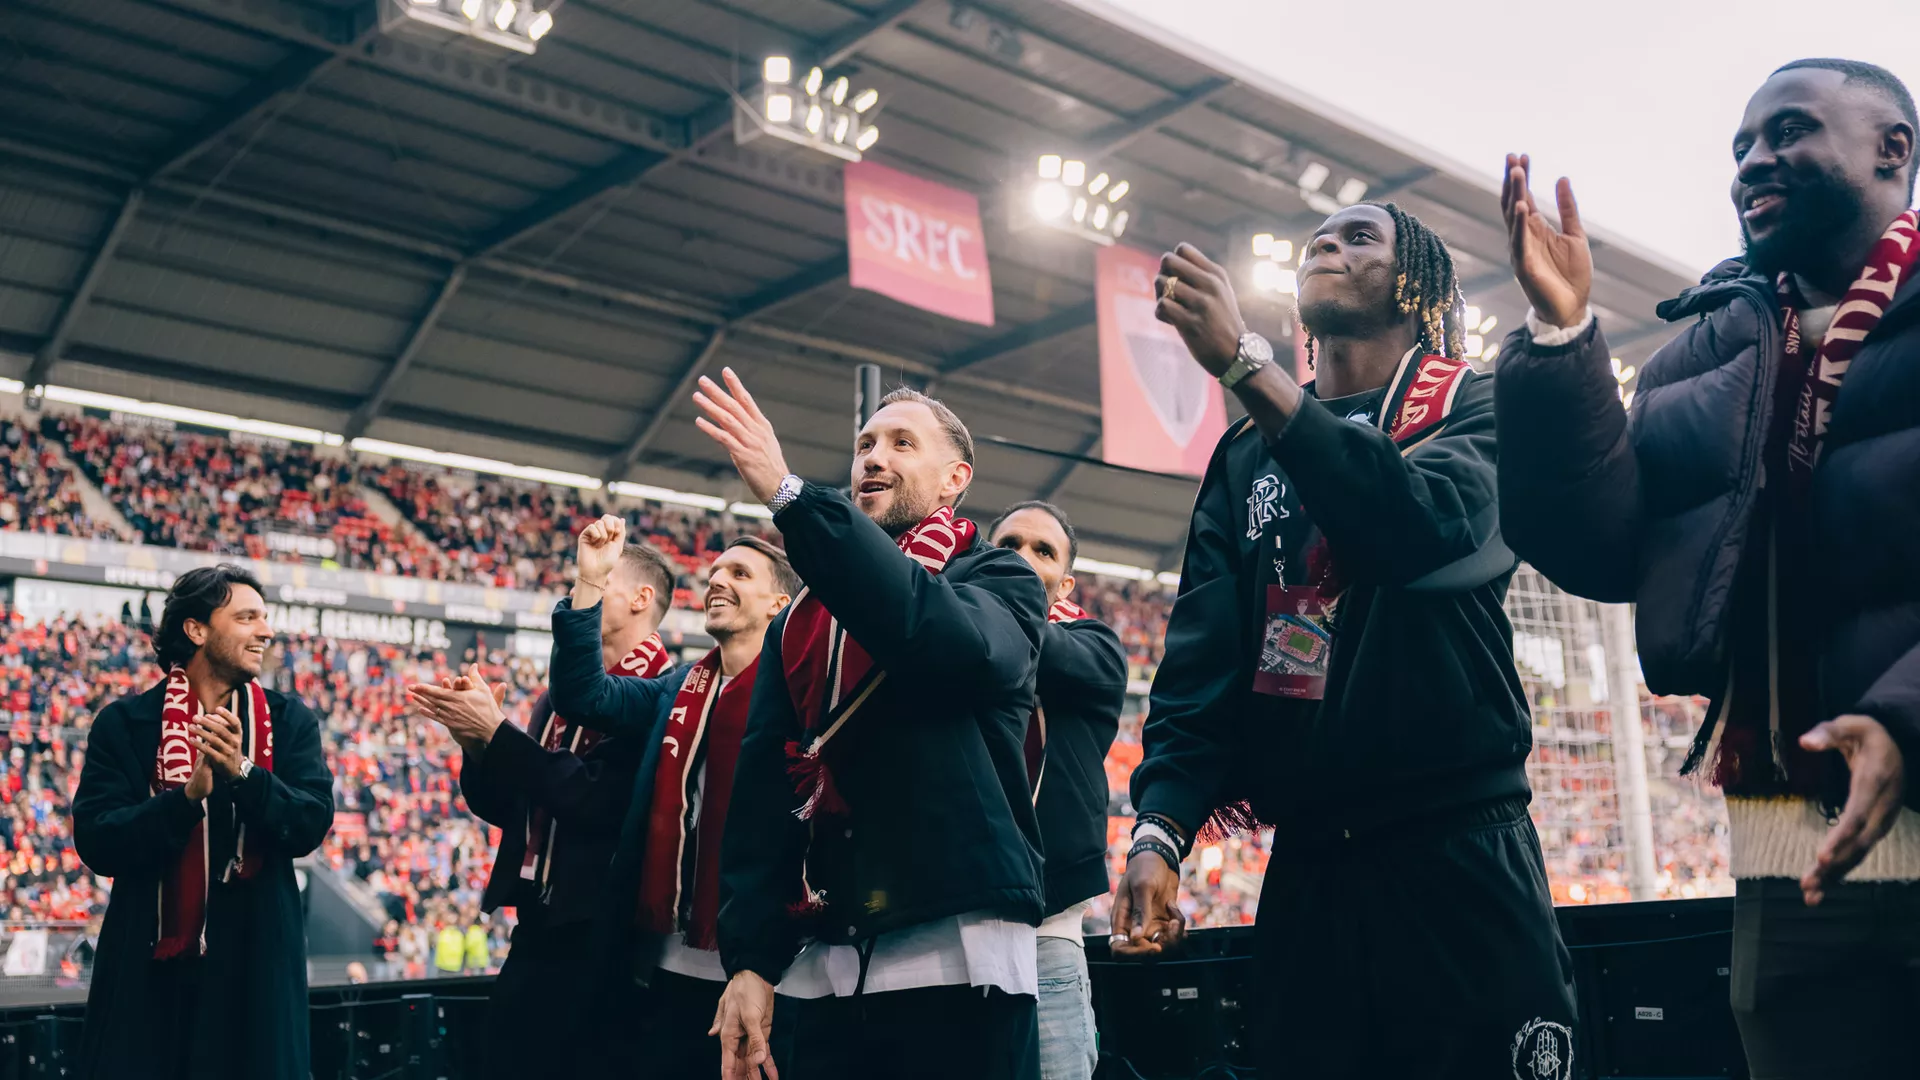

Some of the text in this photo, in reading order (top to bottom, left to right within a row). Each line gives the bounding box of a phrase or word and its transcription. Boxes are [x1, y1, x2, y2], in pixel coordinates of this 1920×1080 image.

[860, 194, 977, 280] SRFC
[320, 609, 414, 645] RENNAIS
[161, 720, 193, 783] ADE
